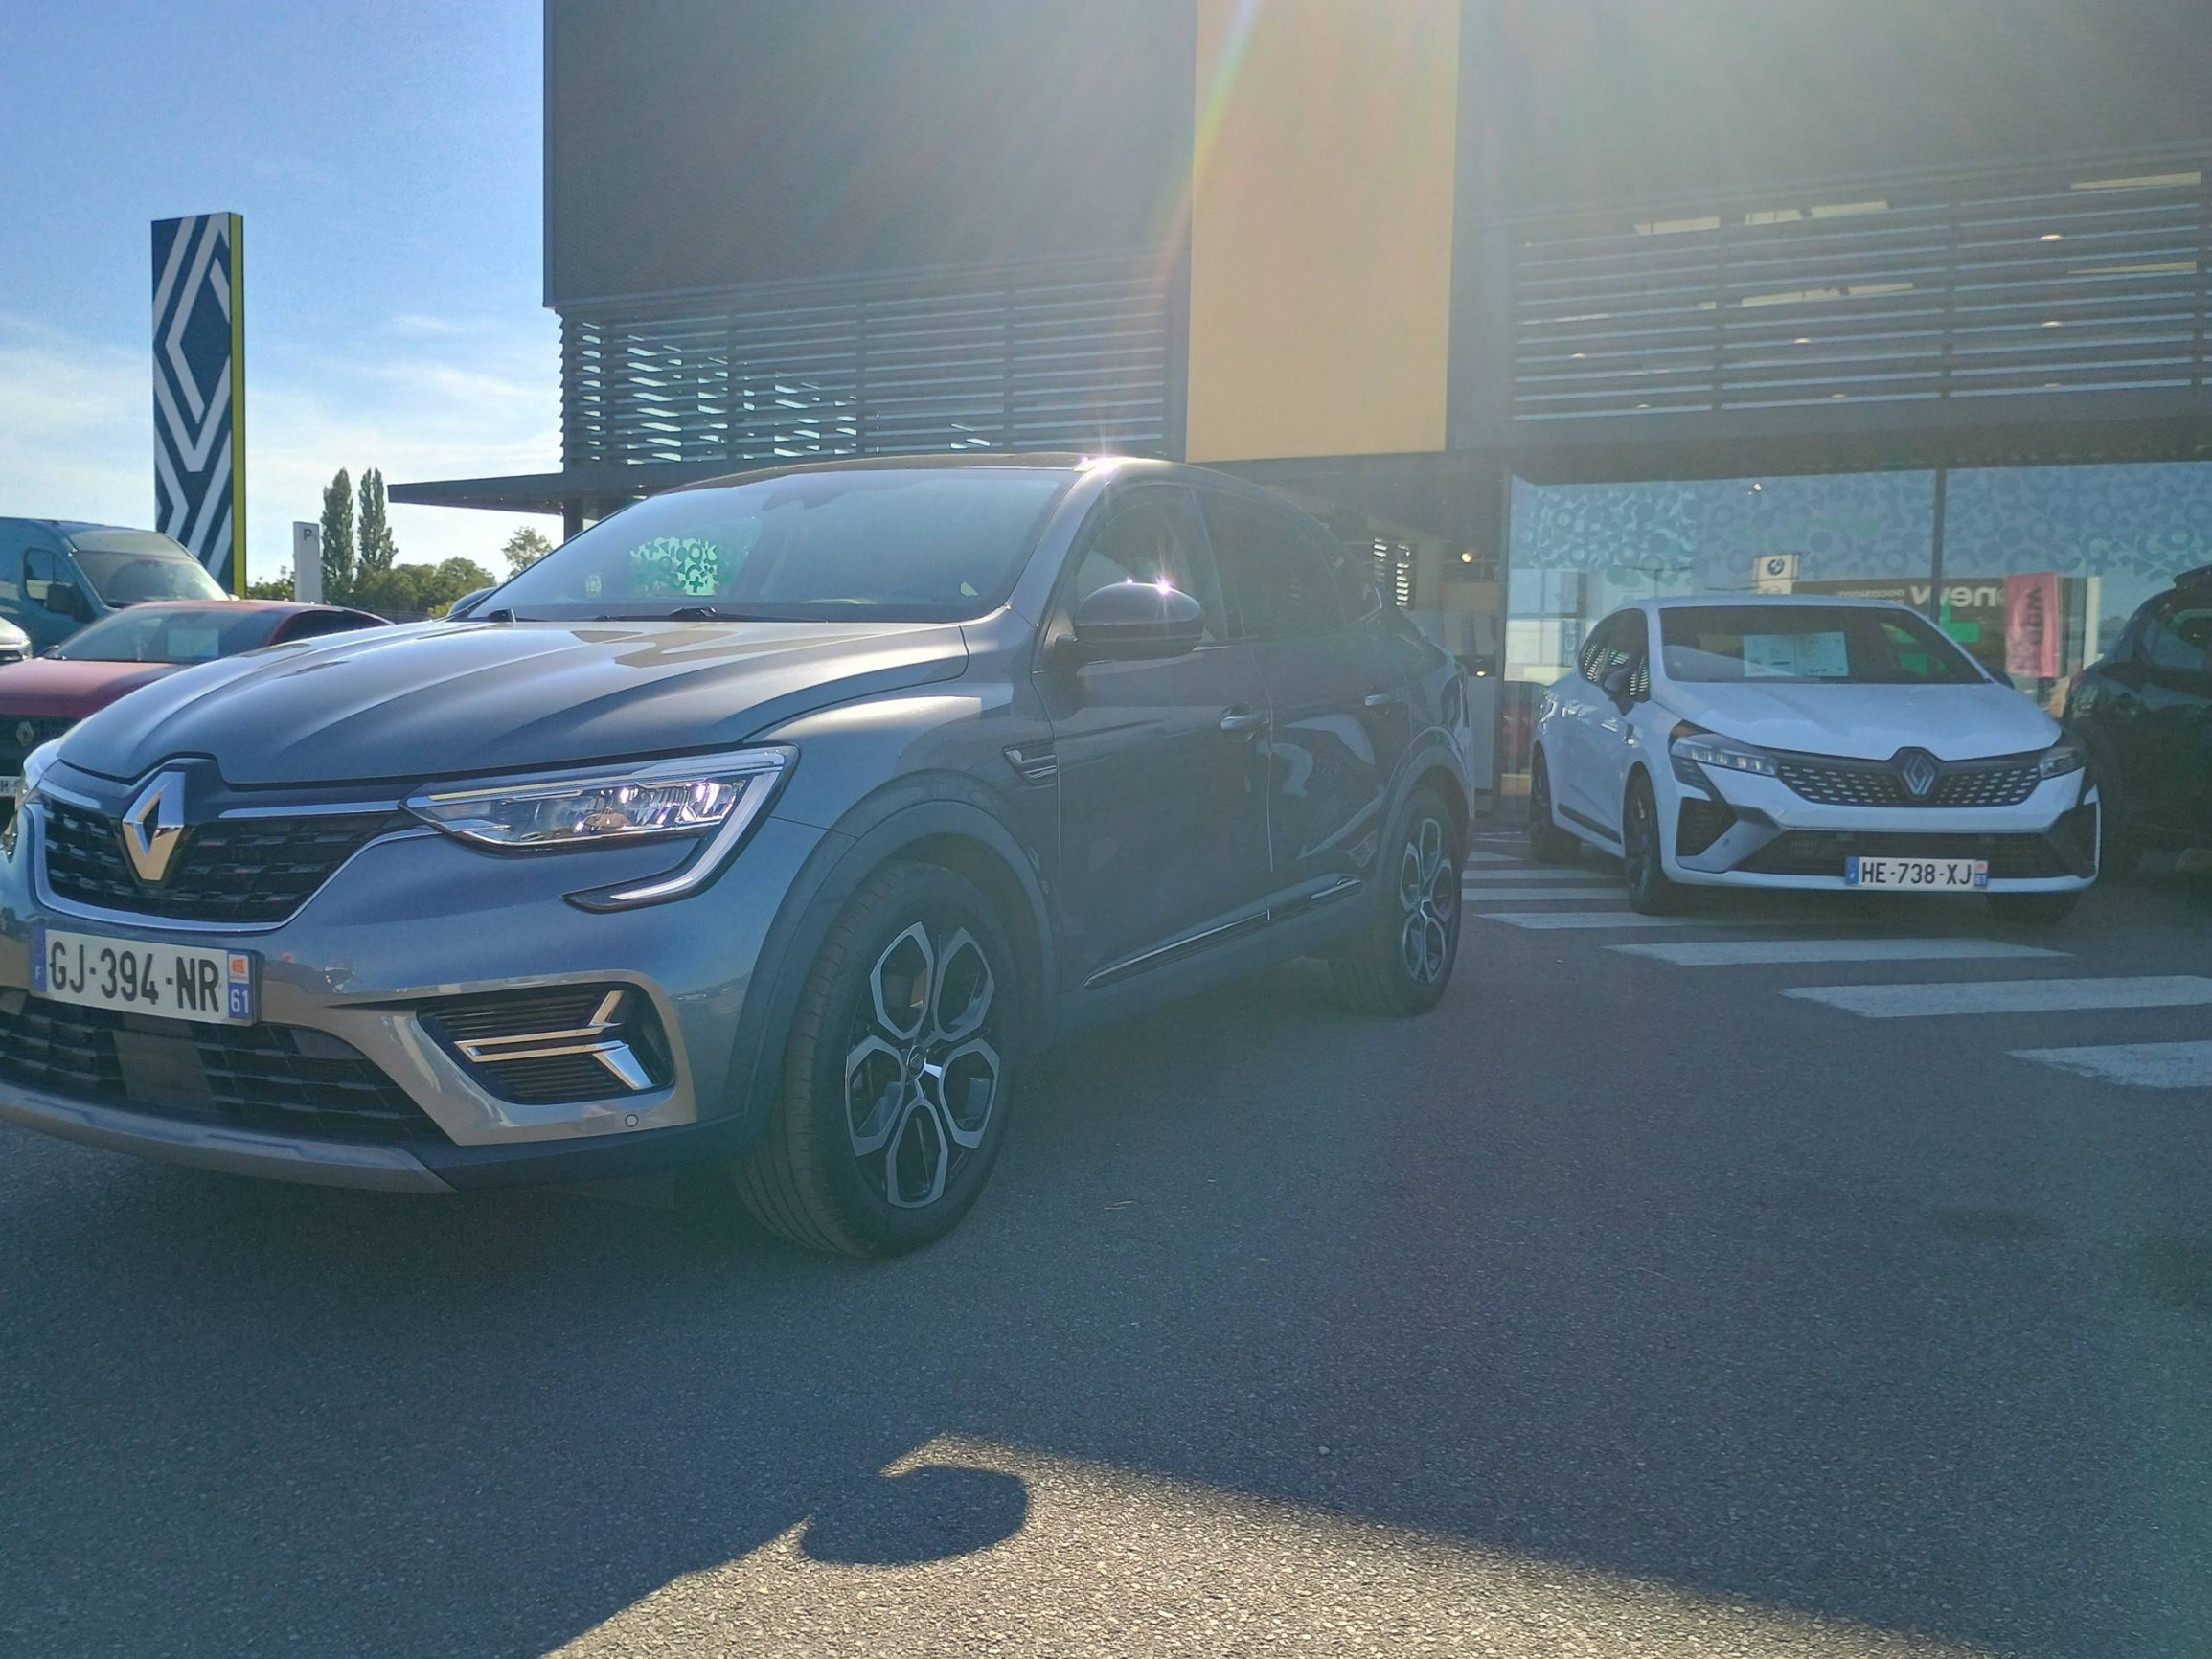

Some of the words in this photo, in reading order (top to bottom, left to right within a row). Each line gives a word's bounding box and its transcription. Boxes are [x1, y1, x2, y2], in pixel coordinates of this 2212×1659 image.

[303, 528, 312, 541] P
[1861, 862, 1972, 885] HE-738-XJ
[50, 941, 219, 1012] GJ-394-NR
[230, 989, 250, 1014] 61
